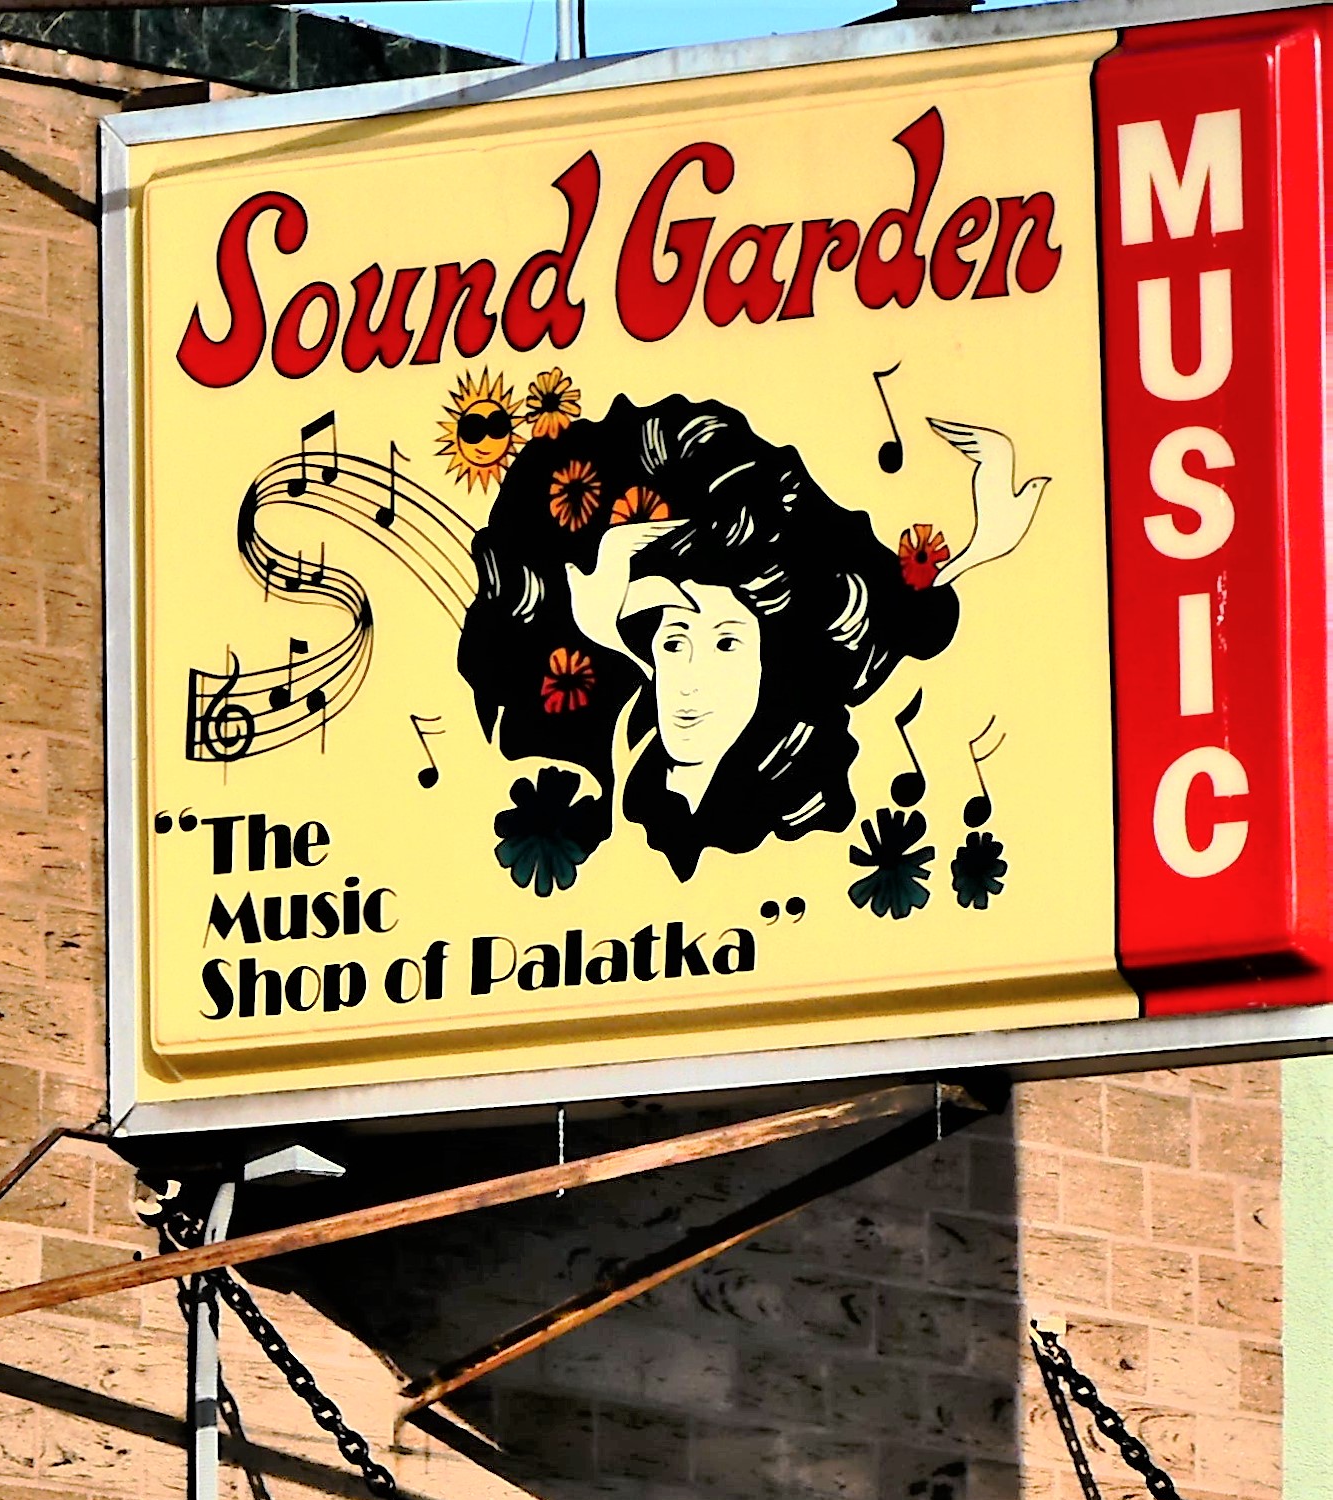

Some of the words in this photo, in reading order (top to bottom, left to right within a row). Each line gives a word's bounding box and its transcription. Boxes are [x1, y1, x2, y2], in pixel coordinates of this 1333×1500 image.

[175, 148, 603, 389] Sound
[613, 104, 1064, 343] Garden
[1116, 107, 1252, 879] MUSIC
[199, 957, 368, 1020] Shop
[384, 939, 452, 1004] of
[202, 876, 399, 950] Music
